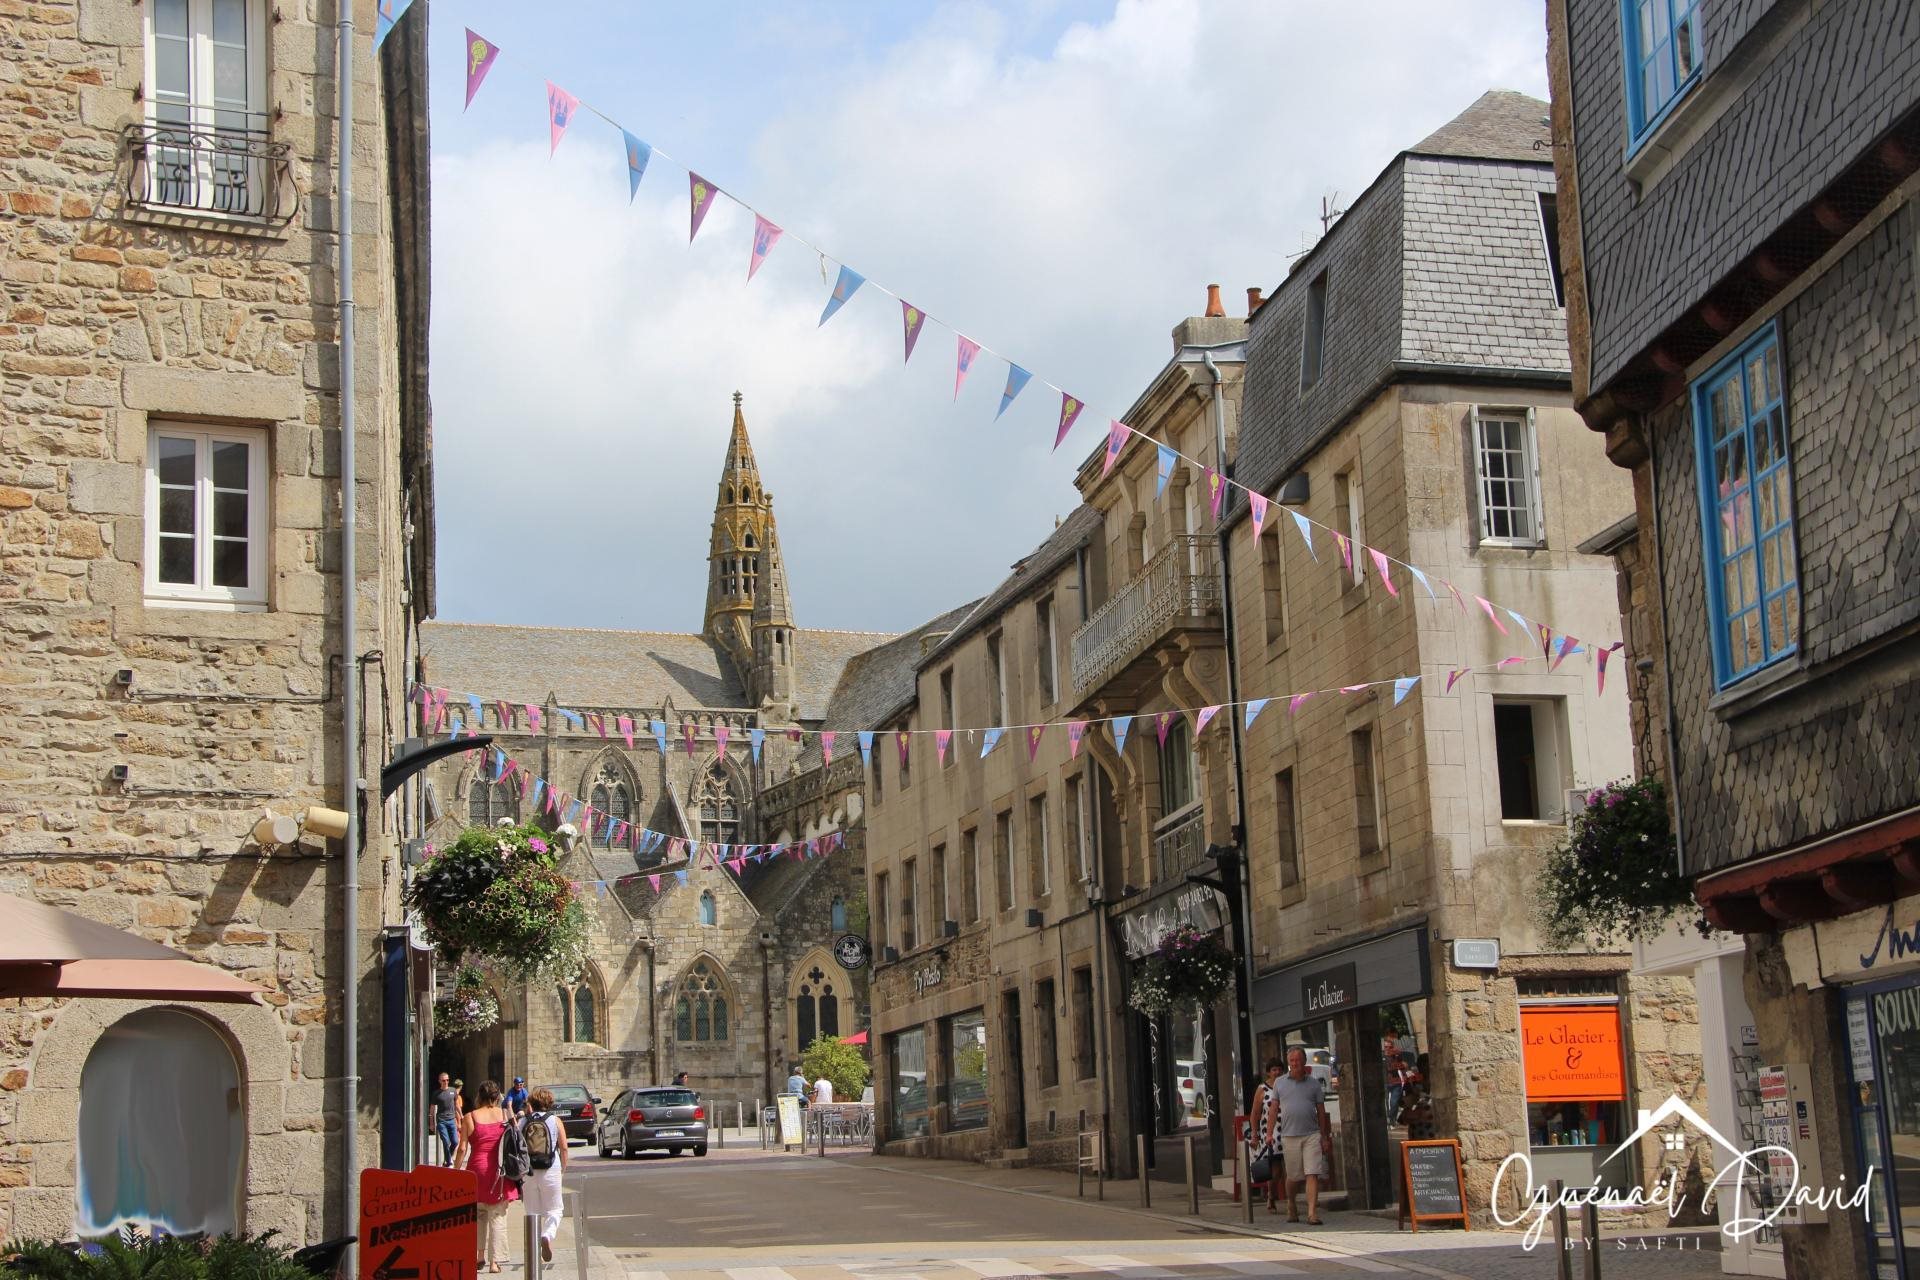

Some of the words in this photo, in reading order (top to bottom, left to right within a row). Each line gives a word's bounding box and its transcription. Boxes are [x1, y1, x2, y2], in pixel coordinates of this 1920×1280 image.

[1308, 988, 1318, 1010] Le
[1525, 1029, 1544, 1045] Le
[1549, 1024, 1604, 1045] Glacier
[1566, 1047, 1582, 1069] &
[1549, 1066, 1619, 1081] Gourmandises
[363, 1185, 423, 1218] Grand
